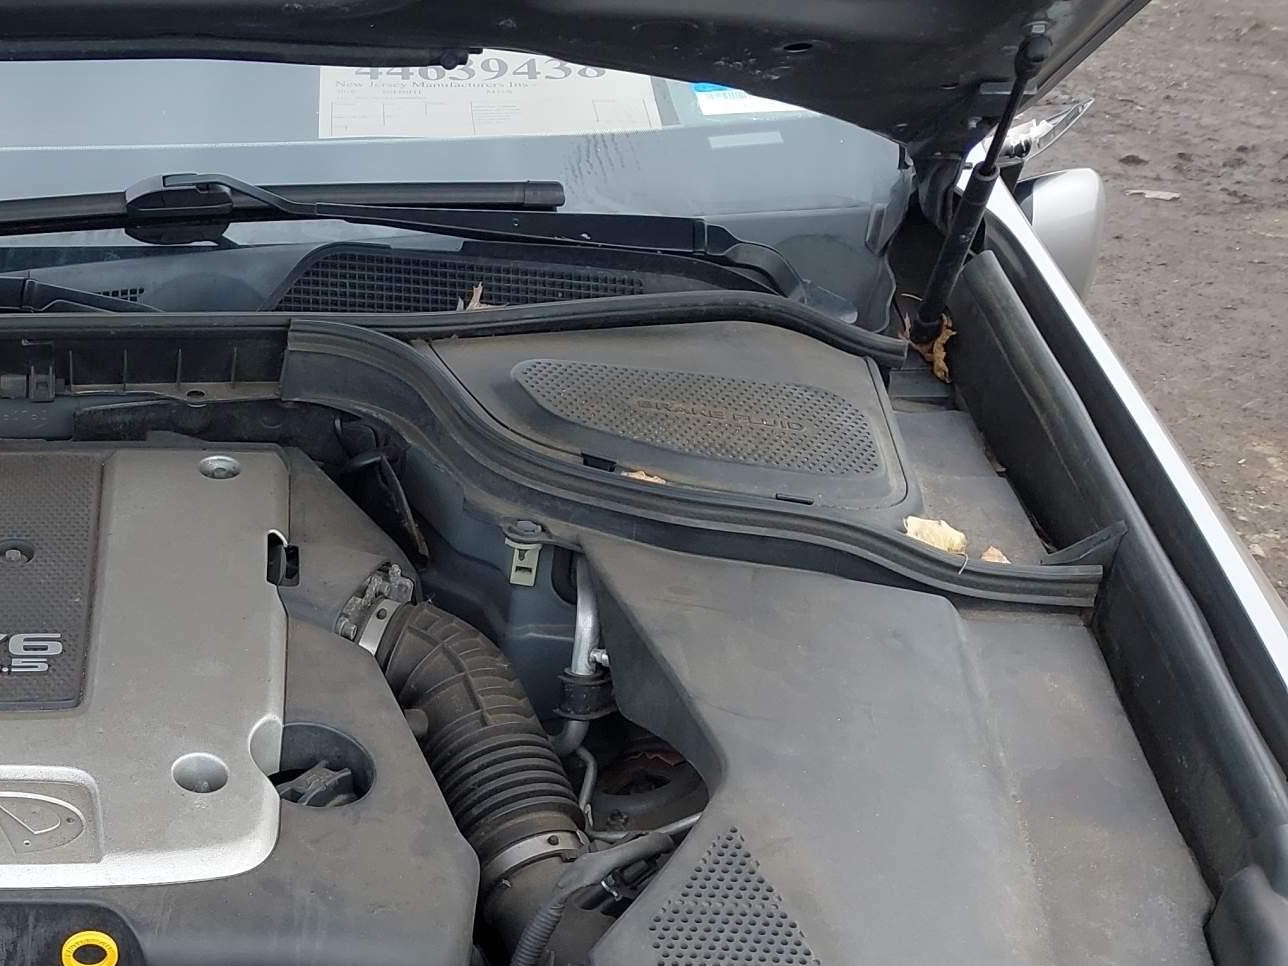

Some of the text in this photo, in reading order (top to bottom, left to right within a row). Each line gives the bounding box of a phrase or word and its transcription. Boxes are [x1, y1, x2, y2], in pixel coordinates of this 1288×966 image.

[336, 80, 365, 88] New
[369, 80, 409, 90] Jersey
[732, 413, 804, 431] FLUID
